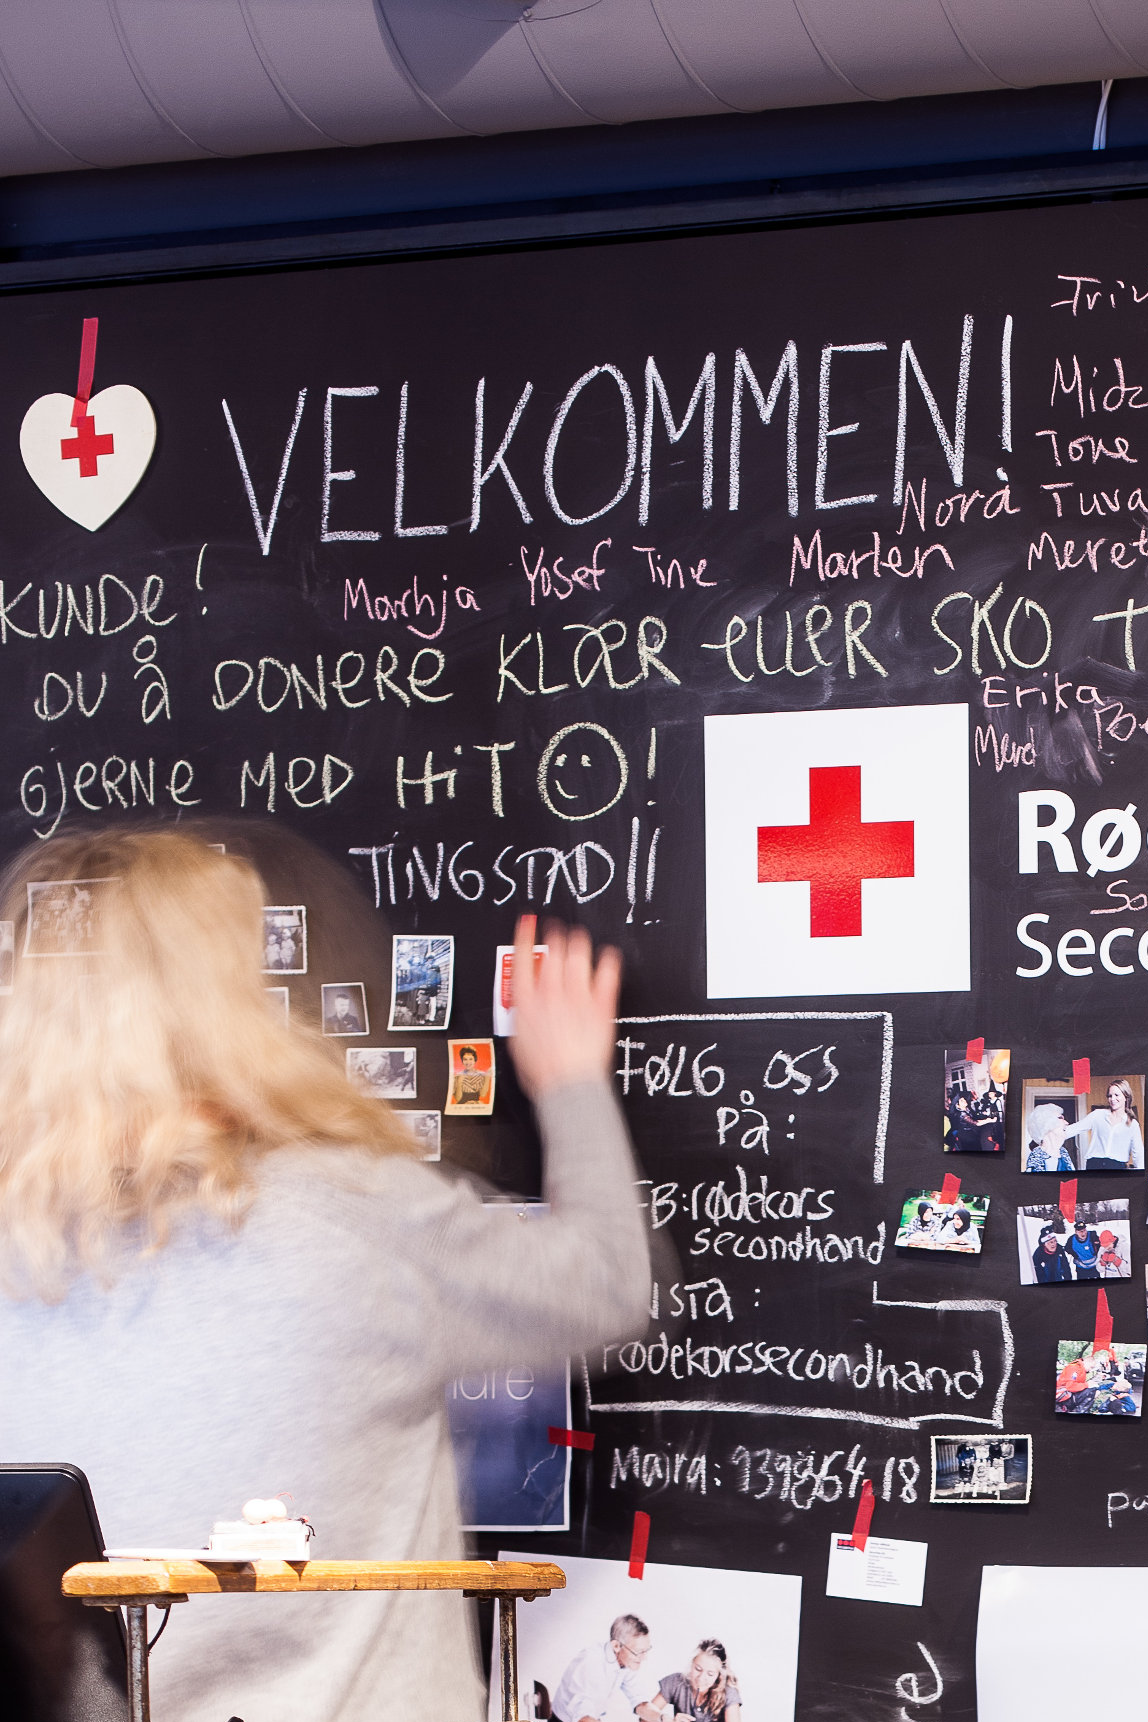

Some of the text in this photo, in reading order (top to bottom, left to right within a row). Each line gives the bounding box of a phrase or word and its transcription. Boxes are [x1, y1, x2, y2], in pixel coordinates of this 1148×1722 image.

[221, 314, 1013, 556] VELKOMMEN!
[1036, 430, 1138, 466] Tone
[897, 478, 1021, 535] Nora
[931, 582, 1052, 677] SKO
[981, 672, 1107, 713] Erika
[690, 1220, 886, 1265] secondhand
